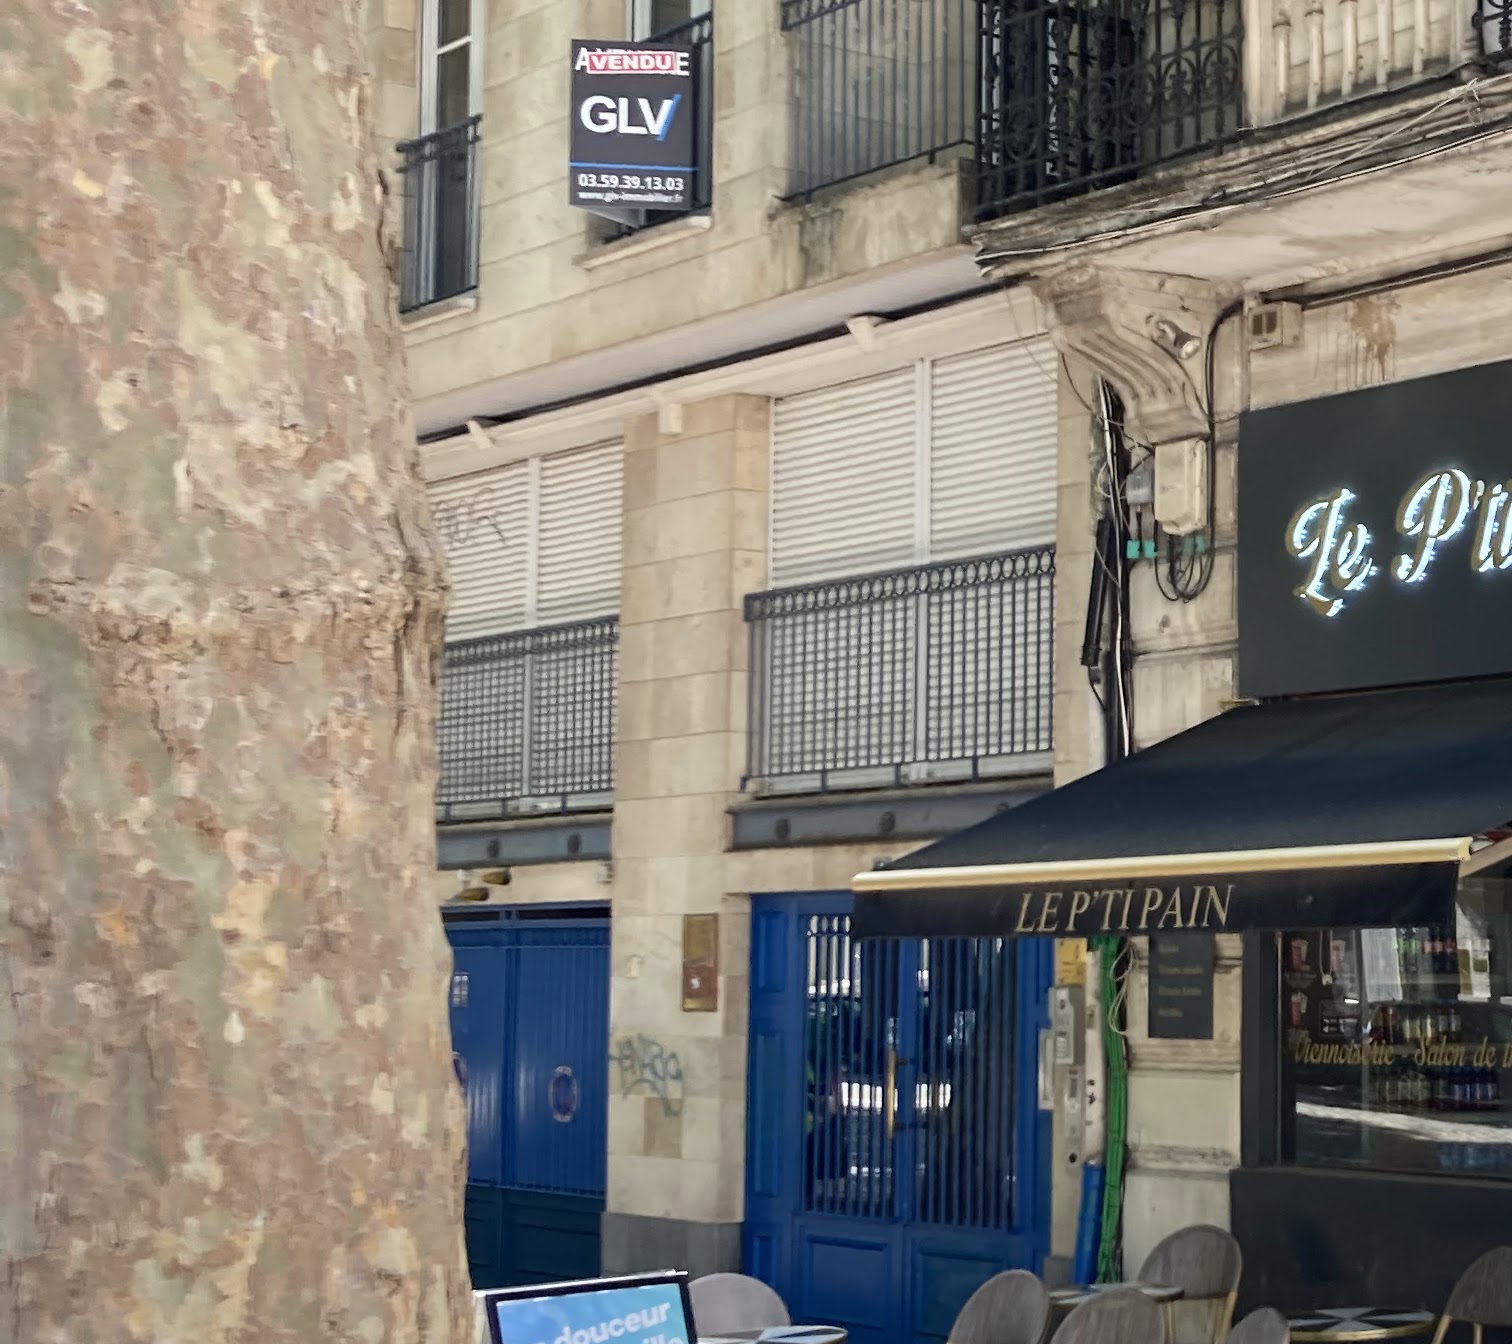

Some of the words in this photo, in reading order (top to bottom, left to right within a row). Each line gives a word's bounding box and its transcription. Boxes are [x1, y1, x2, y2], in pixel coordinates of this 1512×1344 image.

[580, 95, 675, 136] GLV
[1286, 488, 1378, 617] Le
[1015, 892, 1063, 933] LE
[1137, 884, 1236, 929] PAIN
